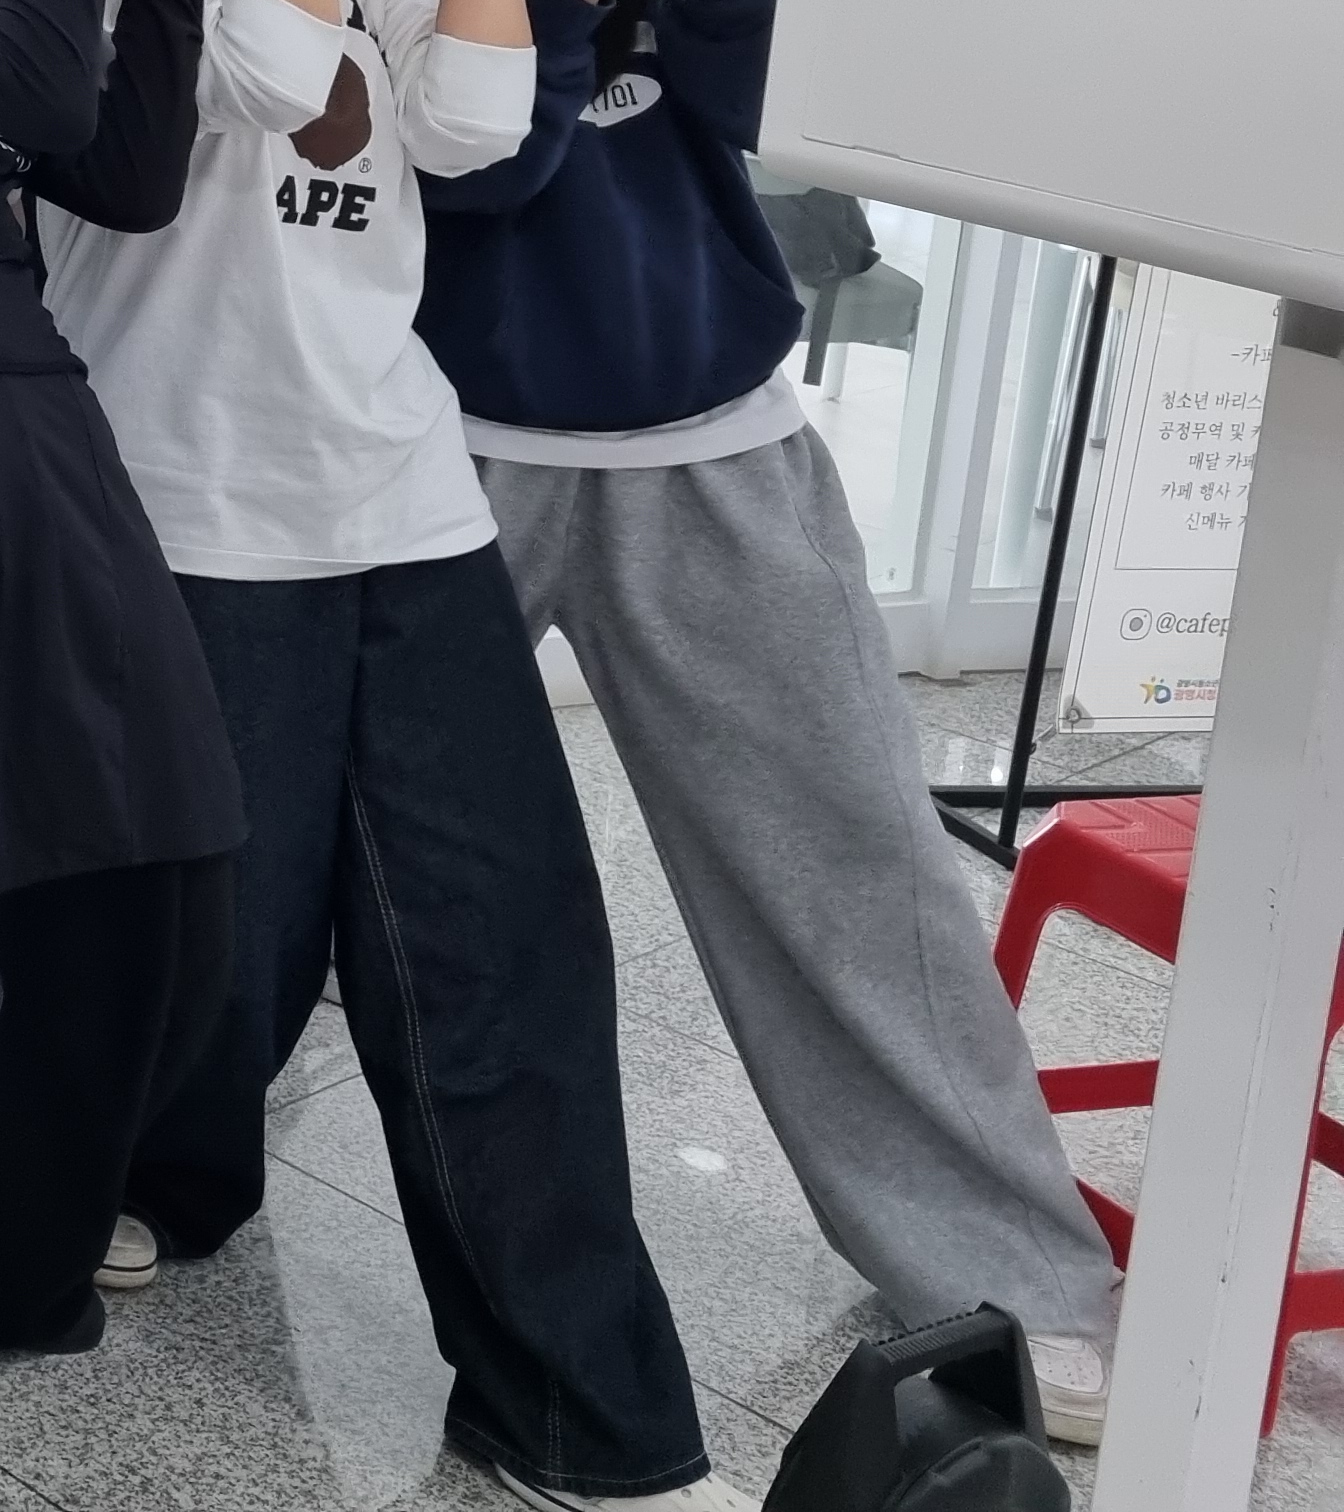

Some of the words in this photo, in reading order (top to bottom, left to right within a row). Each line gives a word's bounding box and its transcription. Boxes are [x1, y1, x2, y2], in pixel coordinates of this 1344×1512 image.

[276, 175, 377, 231] APE
[1161, 390, 1209, 410] 청소년
[1215, 391, 1263, 410] 바리스
[1159, 421, 1223, 441] 공정무역
[1231, 421, 1245, 442] 및
[1189, 451, 1220, 471] 매달
[1161, 481, 1193, 501] 카페
[1200, 481, 1231, 501] 행사
[1186, 511, 1233, 531] 신메뉴
